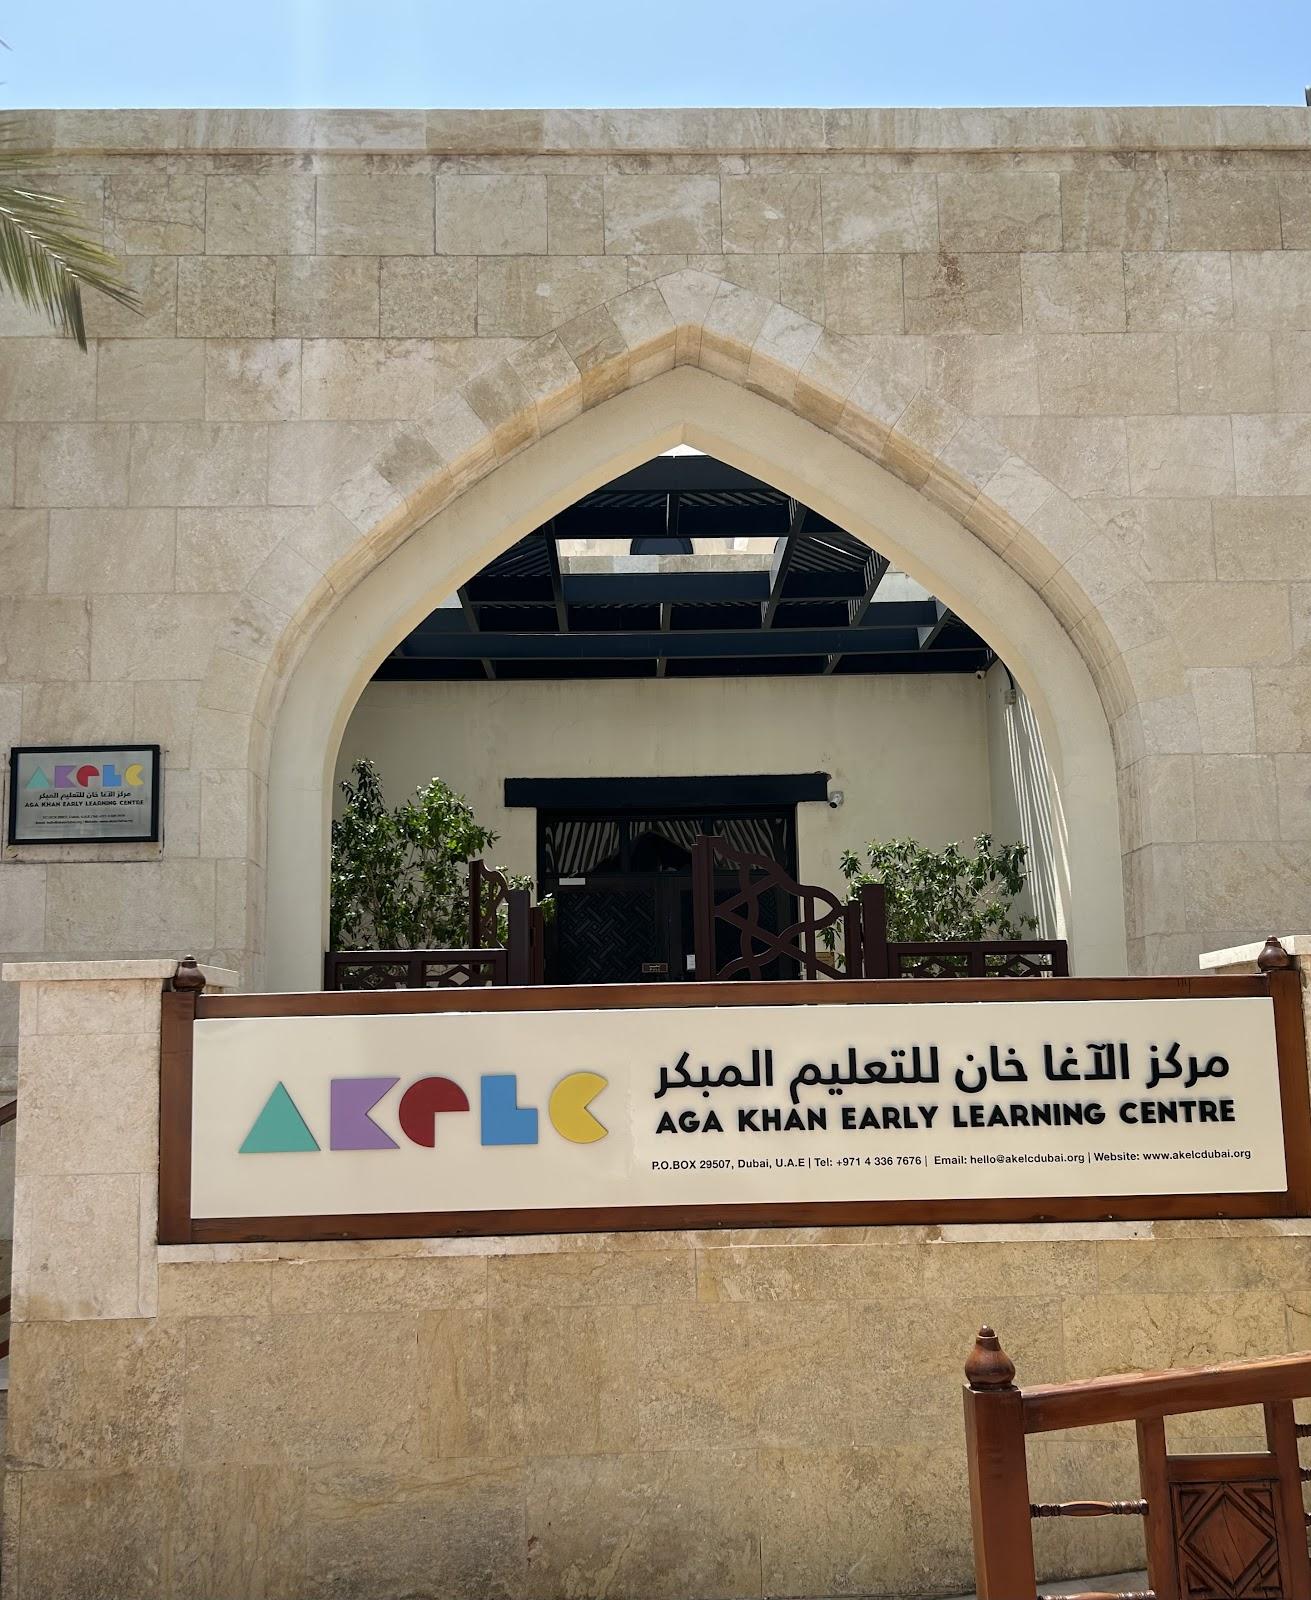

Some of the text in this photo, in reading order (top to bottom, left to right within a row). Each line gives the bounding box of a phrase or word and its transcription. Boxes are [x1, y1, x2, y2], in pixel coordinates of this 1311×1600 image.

[654, 1049, 774, 1099] المبكر
[789, 1046, 940, 1105] للتعليم
[954, 1045, 1028, 1094] خان
[1145, 1041, 1229, 1089] مركز
[655, 1099, 1236, 1134] AGA KHAN EARLY LEARNING CENTRE
[652, 1160, 696, 1170] P.O.BOX
[699, 1159, 734, 1170] 29507,
[737, 1158, 772, 1169] Dubai,
[775, 1158, 805, 1167] U.A.E
[814, 1157, 832, 1167] Tel:
[836, 1157, 860, 1166] +971
[864, 1157, 871, 1165] 4
[874, 1156, 893, 1166] 336
[896, 1156, 922, 1165] 7676
[934, 1155, 967, 1165] Email:
[970, 1153, 1085, 1164] hello@akelcdubai.org
[1093, 1151, 1139, 1161] Website:
[1142, 1149, 1251, 1160] www.akelcdubai.org
